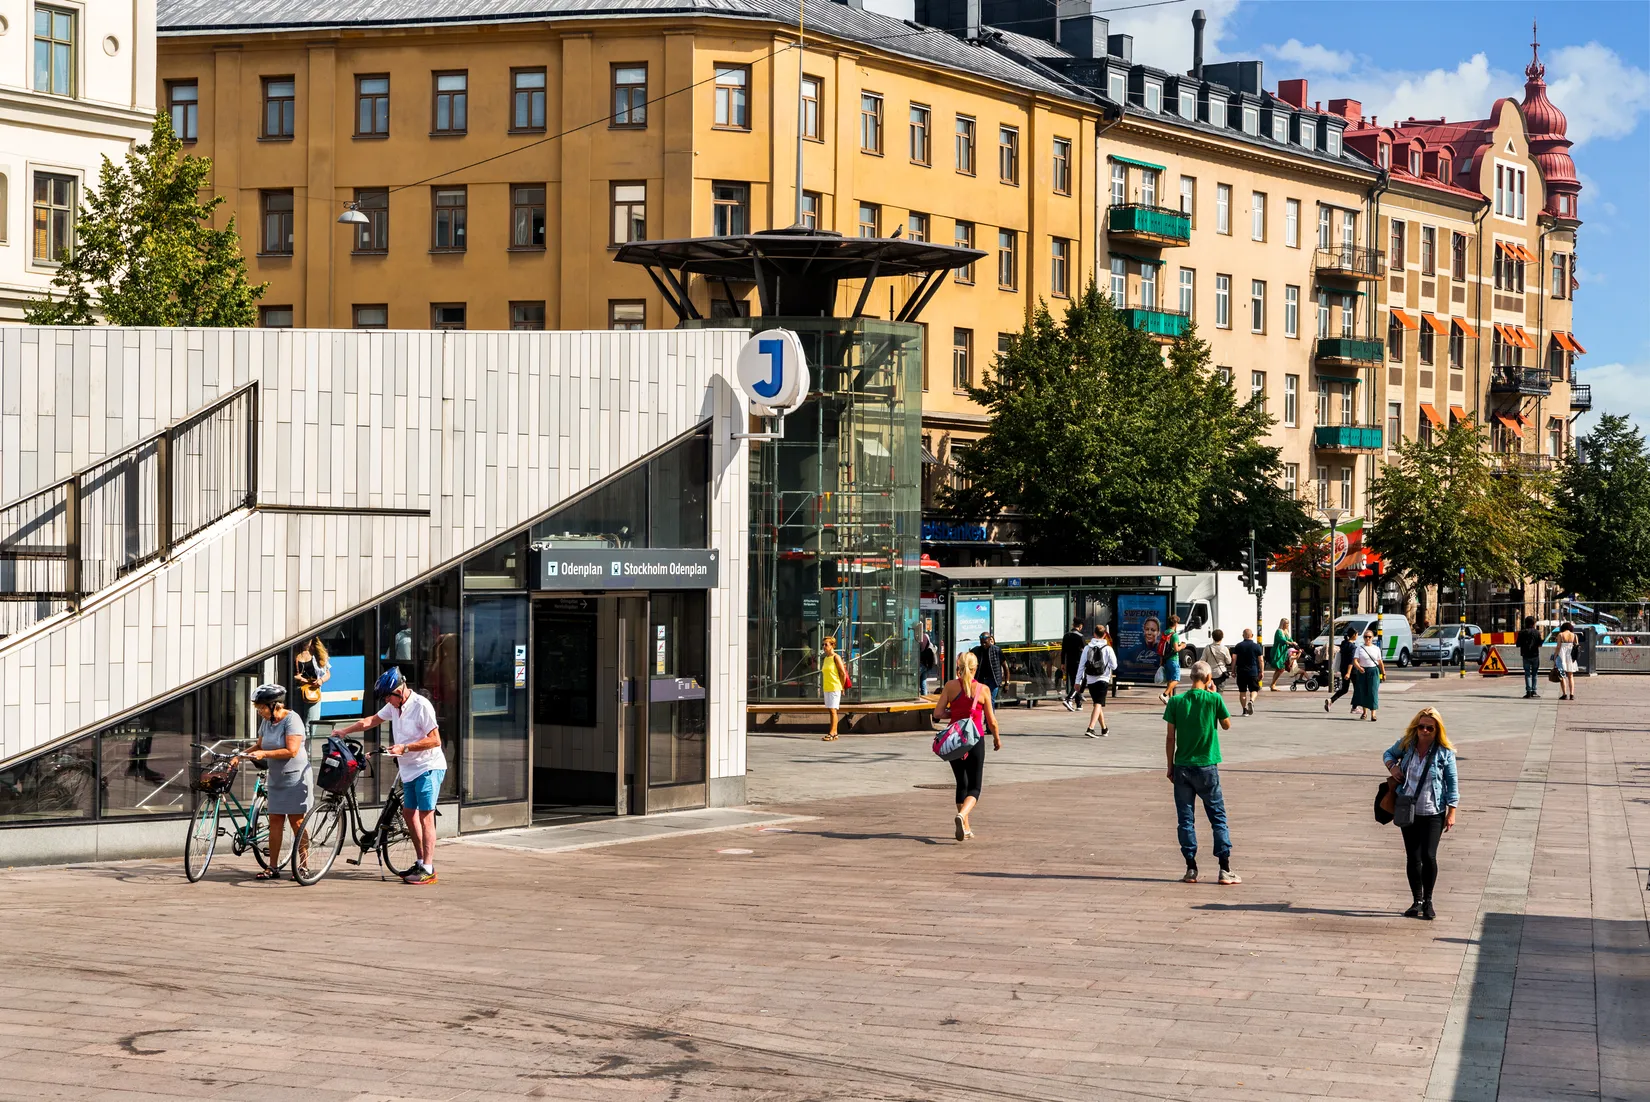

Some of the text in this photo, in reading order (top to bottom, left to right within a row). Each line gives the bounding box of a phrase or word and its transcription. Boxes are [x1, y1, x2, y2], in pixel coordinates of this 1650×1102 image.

[752, 339, 784, 399] J
[550, 562, 708, 577] T Odenplan Stockholm Odenplan
[938, 594, 945, 603] C
